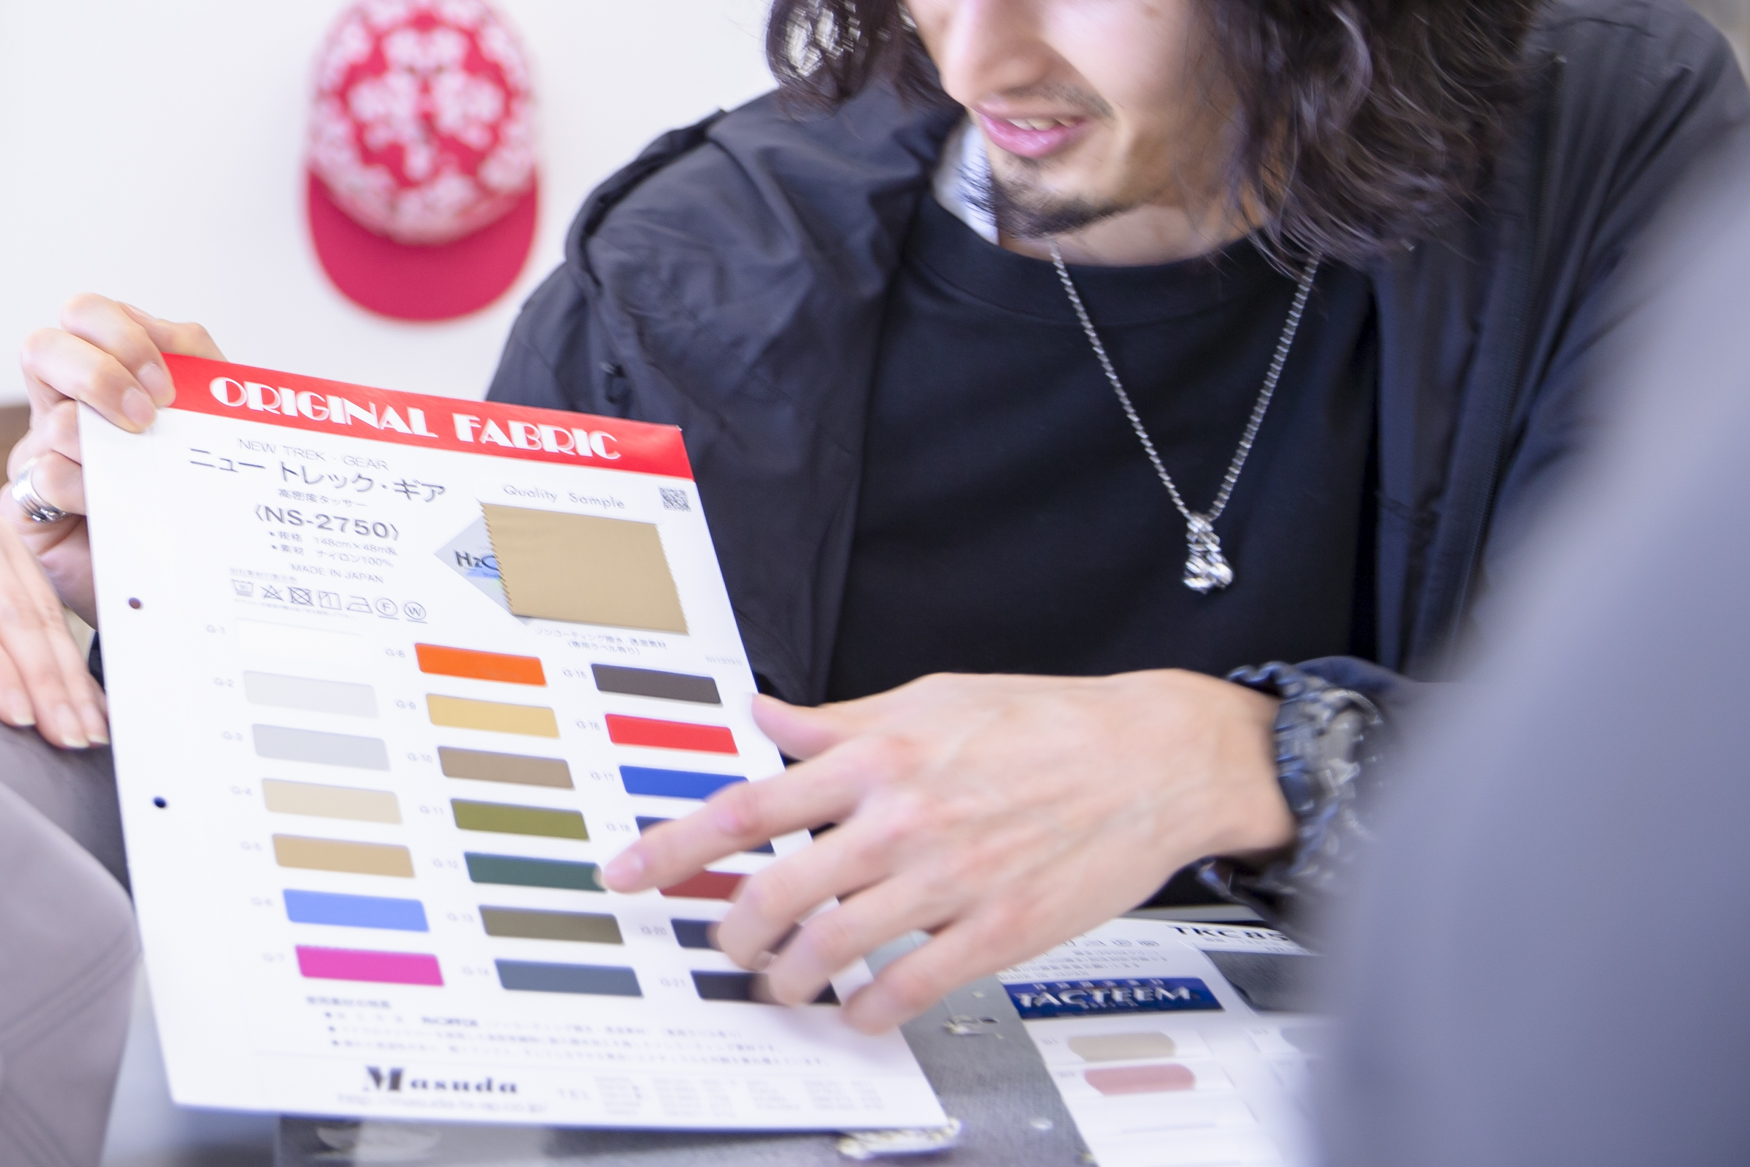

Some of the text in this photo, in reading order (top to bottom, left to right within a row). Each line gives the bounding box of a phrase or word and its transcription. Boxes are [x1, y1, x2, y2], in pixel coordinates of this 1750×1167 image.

[210, 376, 622, 460] ORIGINAL FABRIC
[237, 437, 390, 471] NEW TREK GEAR
[188, 447, 447, 503] ニュー トレック・ギア
[503, 484, 626, 511] Quality Sample
[290, 562, 326, 576] MADE
[330, 568, 342, 578] IN
[344, 571, 384, 584] JAPAN
[362, 1065, 518, 1094] Masuda
